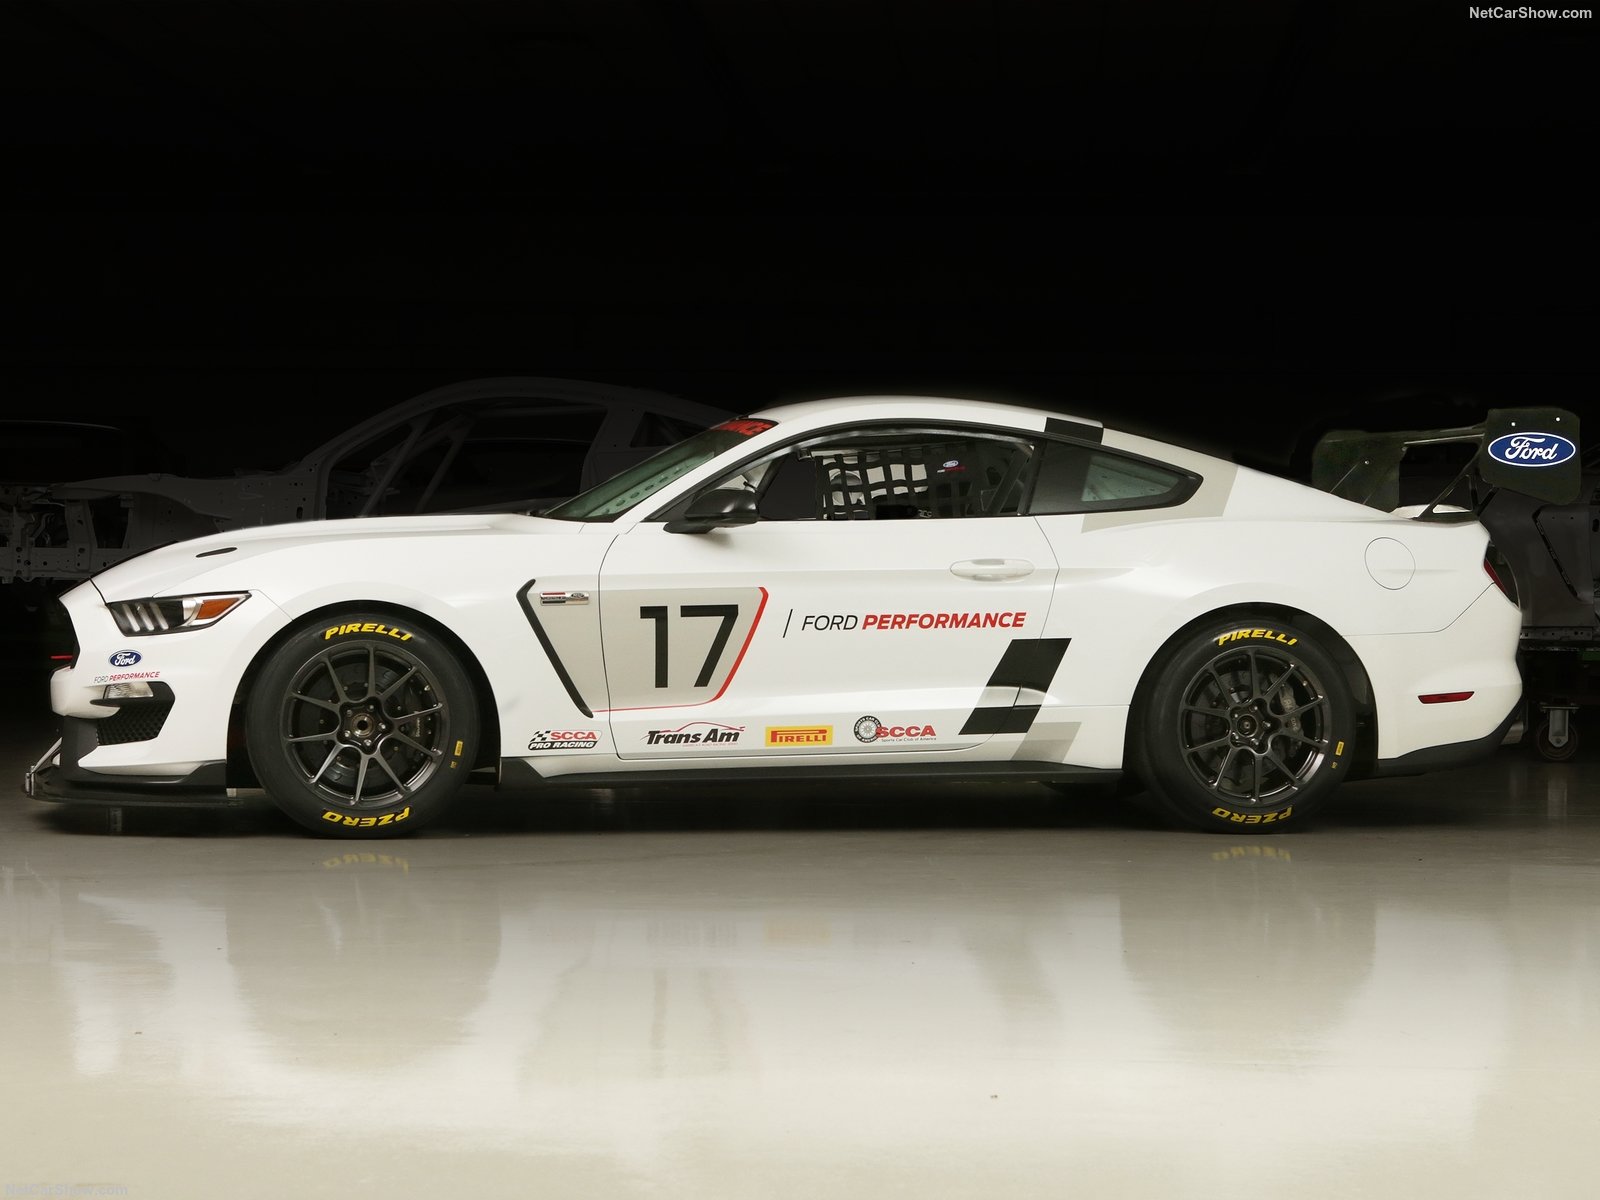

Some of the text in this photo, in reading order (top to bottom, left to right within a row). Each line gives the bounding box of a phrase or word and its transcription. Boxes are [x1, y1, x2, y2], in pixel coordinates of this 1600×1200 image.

[1504, 435, 1559, 460] Ford
[801, 611, 1027, 631] FORD PERFORMANCE
[324, 622, 413, 641] PIRELLI
[1218, 628, 1298, 646] PIRELLI
[639, 604, 739, 688] 17
[114, 651, 137, 666] Ford
[94, 671, 161, 684] FORD PERFORMANCE
[550, 731, 597, 741] SCCA
[646, 728, 740, 745] Trans Am
[770, 729, 828, 743] PIRELLI
[875, 725, 937, 738] SCCA
[529, 741, 595, 750] PRO RACING
[322, 806, 410, 828] PZERO
[1211, 806, 1293, 824] PZERO
